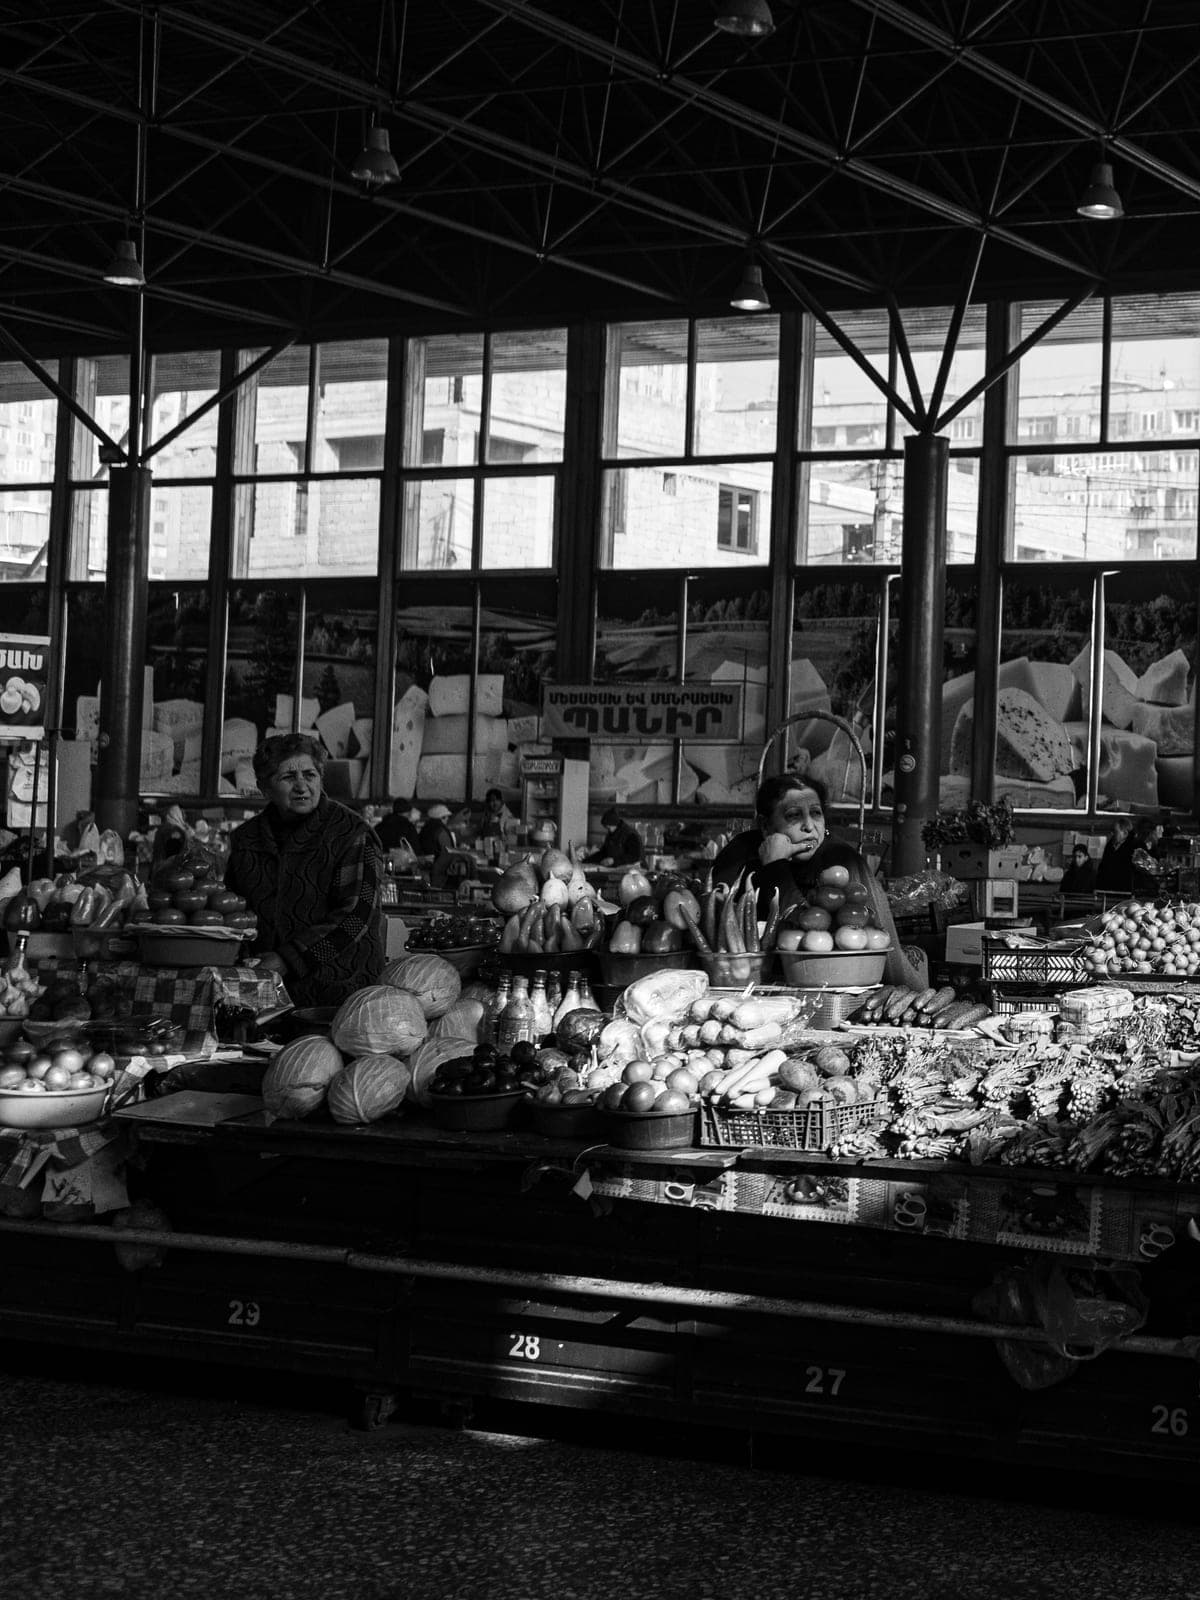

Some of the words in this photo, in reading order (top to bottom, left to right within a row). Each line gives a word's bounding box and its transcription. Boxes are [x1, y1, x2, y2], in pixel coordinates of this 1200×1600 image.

[563, 706, 722, 734] ՊԱՆԻՐ
[228, 1300, 260, 1327] 29
[508, 1333, 540, 1360] 28
[804, 1366, 846, 1396] 27
[1151, 1404, 1189, 1436] 26
